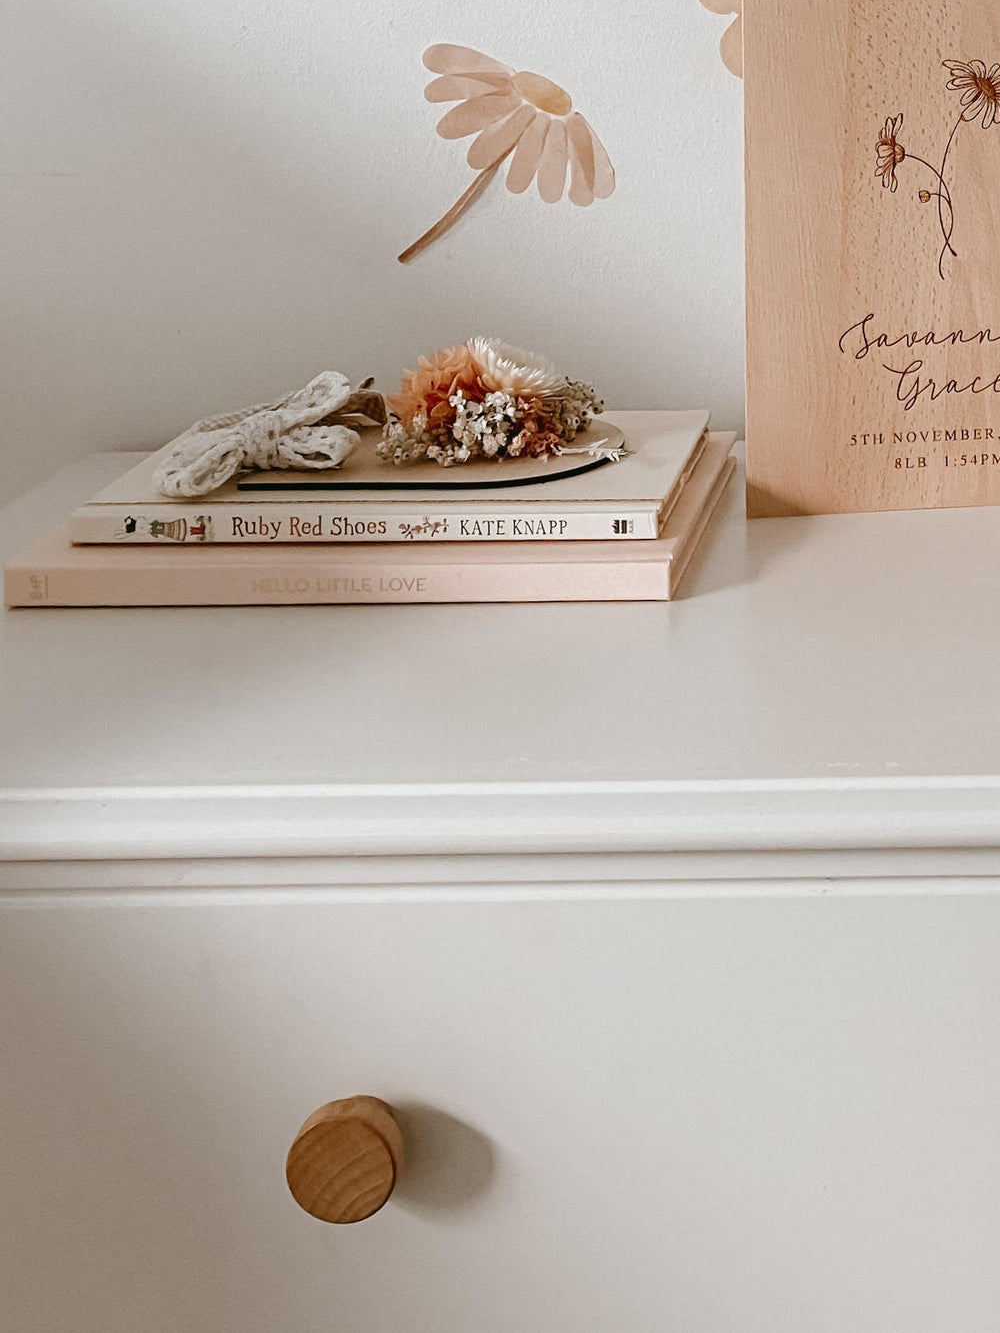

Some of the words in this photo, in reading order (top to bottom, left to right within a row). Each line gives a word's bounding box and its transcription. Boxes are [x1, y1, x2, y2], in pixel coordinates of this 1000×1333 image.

[849, 433, 884, 447] 5TH
[894, 457, 927, 469] 8LB
[231, 516, 282, 540] Ruby
[289, 515, 324, 537] Red
[330, 516, 388, 535] Shoes
[460, 519, 506, 536] KATE
[512, 518, 569, 535] KNAPP
[252, 577, 309, 594] HELLO
[316, 577, 372, 592] LITTLE
[379, 577, 427, 592] LOVE
